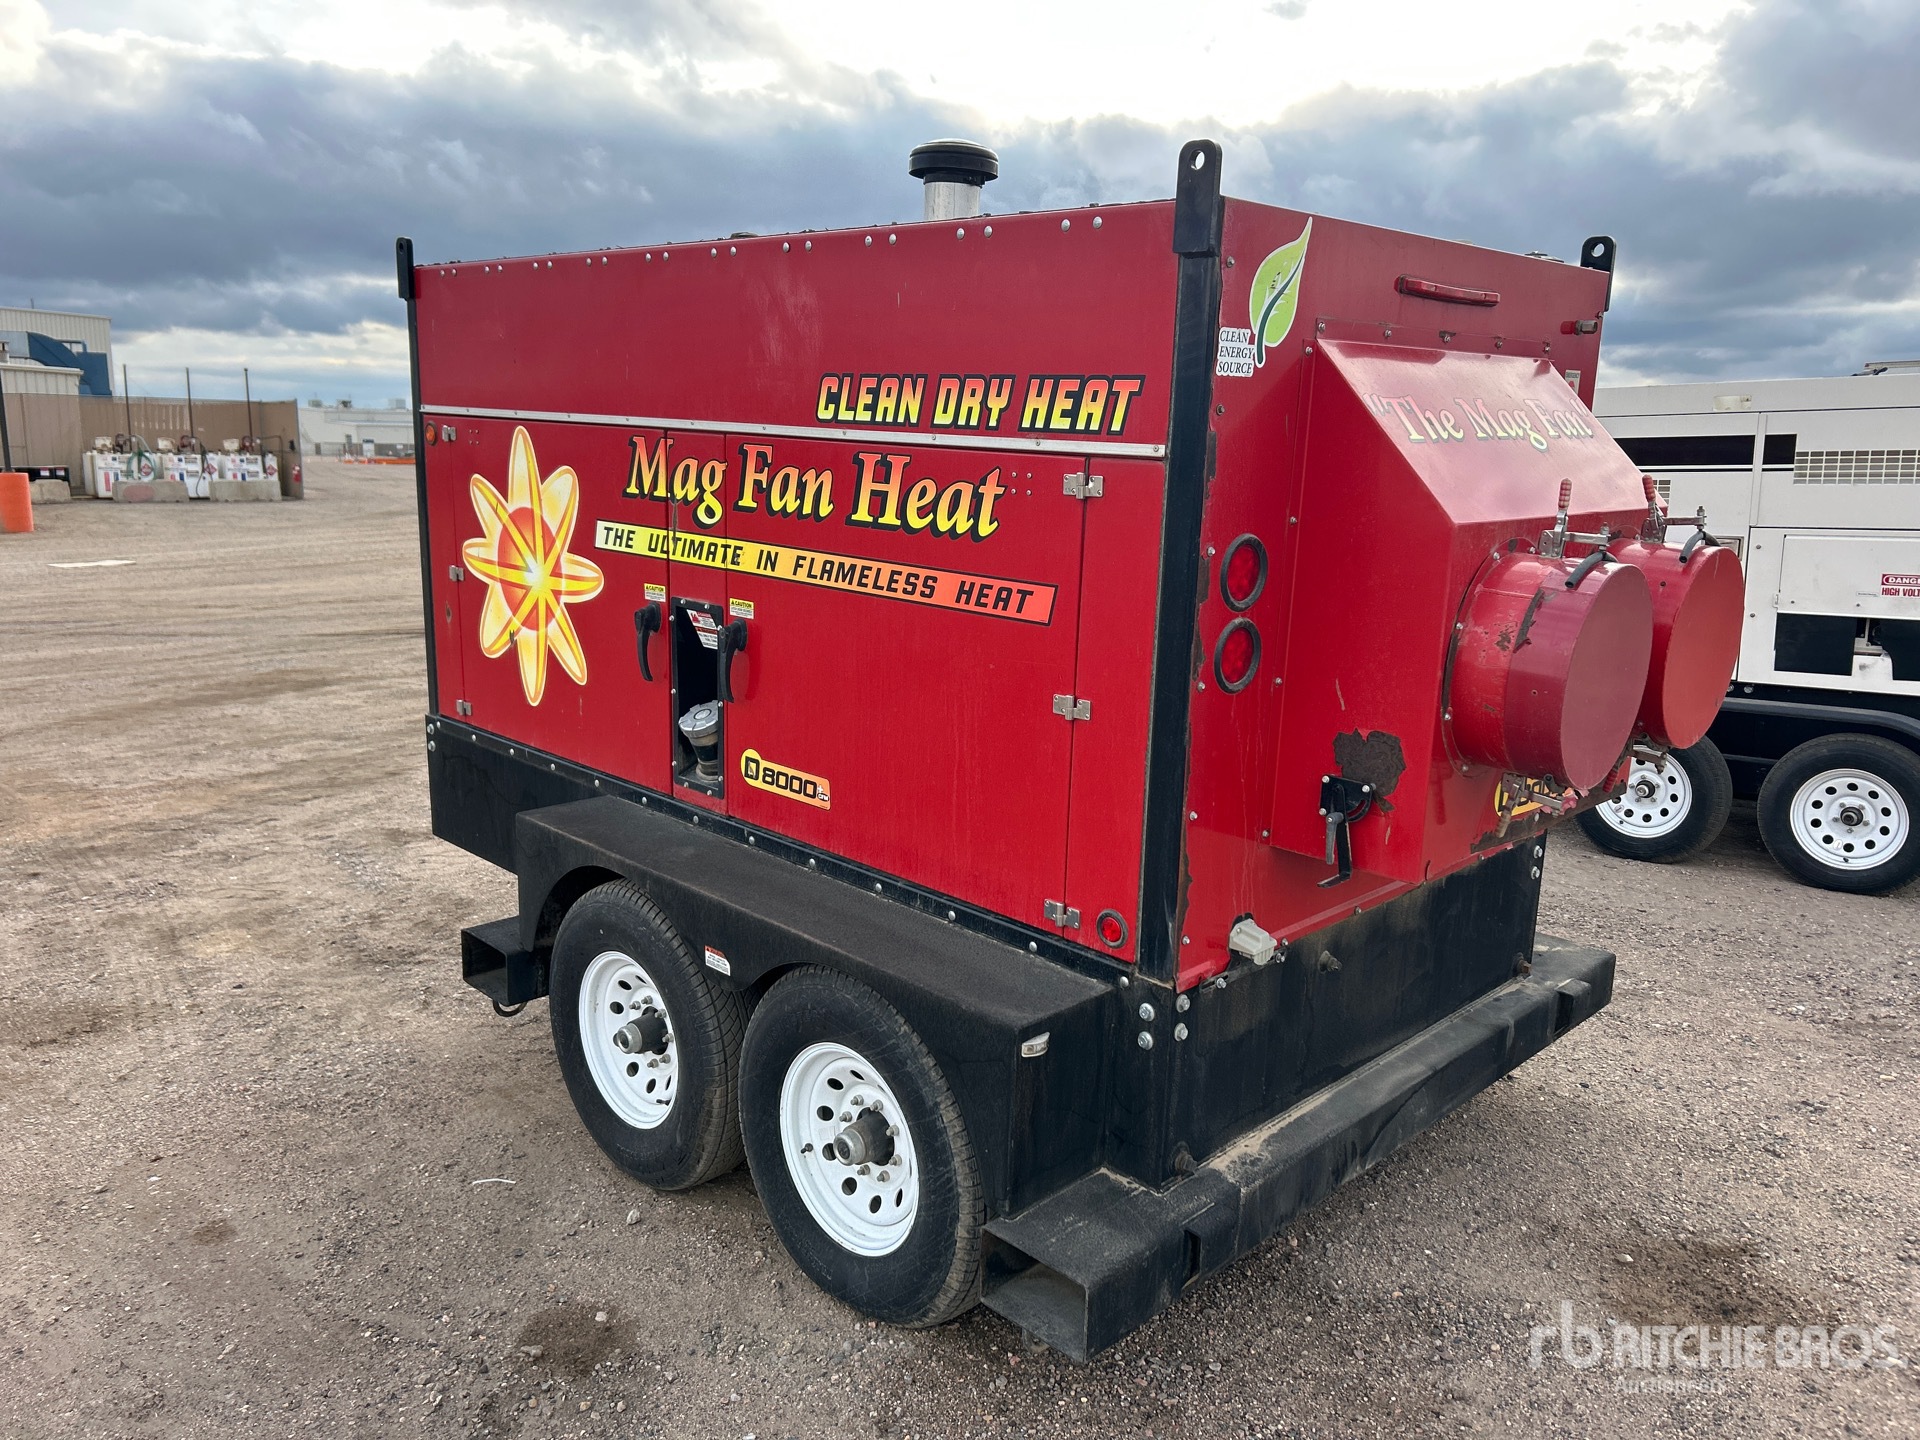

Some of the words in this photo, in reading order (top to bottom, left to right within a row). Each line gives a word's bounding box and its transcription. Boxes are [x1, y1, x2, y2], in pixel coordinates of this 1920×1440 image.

[1220, 330, 1249, 343] CLEAN
[1219, 346, 1254, 359] ENERGY
[1218, 361, 1252, 373] SOURCE
[816, 373, 927, 426] CLEAN
[930, 373, 1016, 430] DRY
[1018, 375, 1145, 435] HEAT
[1454, 398, 1548, 452] Mag
[622, 435, 727, 528] Mag
[733, 442, 834, 520] Fan
[845, 452, 1006, 543] Heat
[604, 526, 636, 549] THE
[648, 532, 743, 567] ULTIMATE
[756, 549, 779, 572] IN
[792, 555, 939, 599] FLAMELESS
[955, 580, 1034, 614] HEAT
[1881, 587, 1900, 596] HIGH
[735, 600, 752, 609] CAUTION
